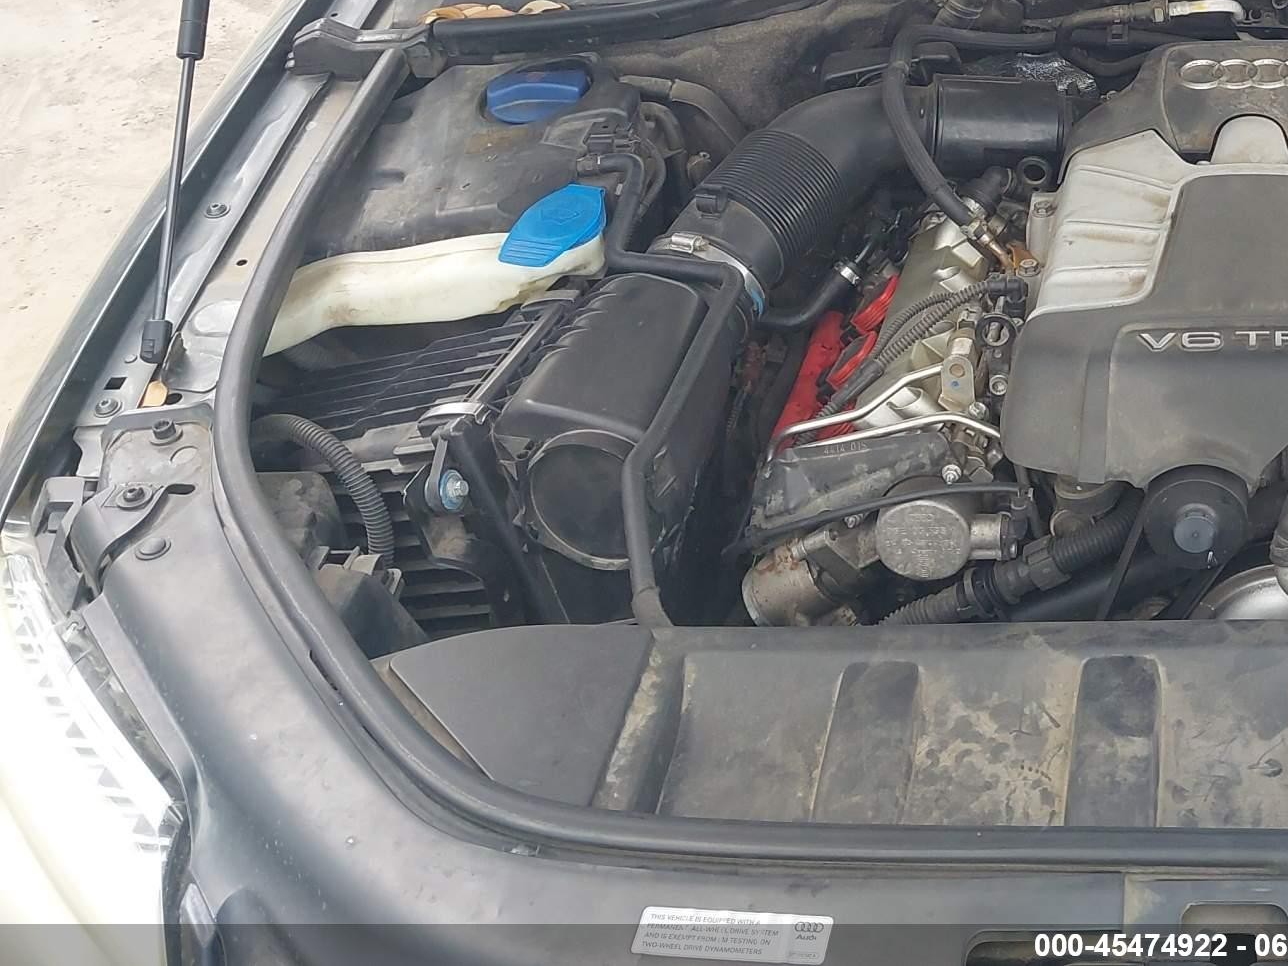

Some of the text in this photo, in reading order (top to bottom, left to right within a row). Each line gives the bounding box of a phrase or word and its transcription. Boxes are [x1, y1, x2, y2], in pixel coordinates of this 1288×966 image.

[1137, 331, 1223, 351] V6
[642, 941, 682, 950] TWO-WHEEL
[704, 944, 763, 954] DYNAMOMETERS
[730, 937, 758, 945] TESTING
